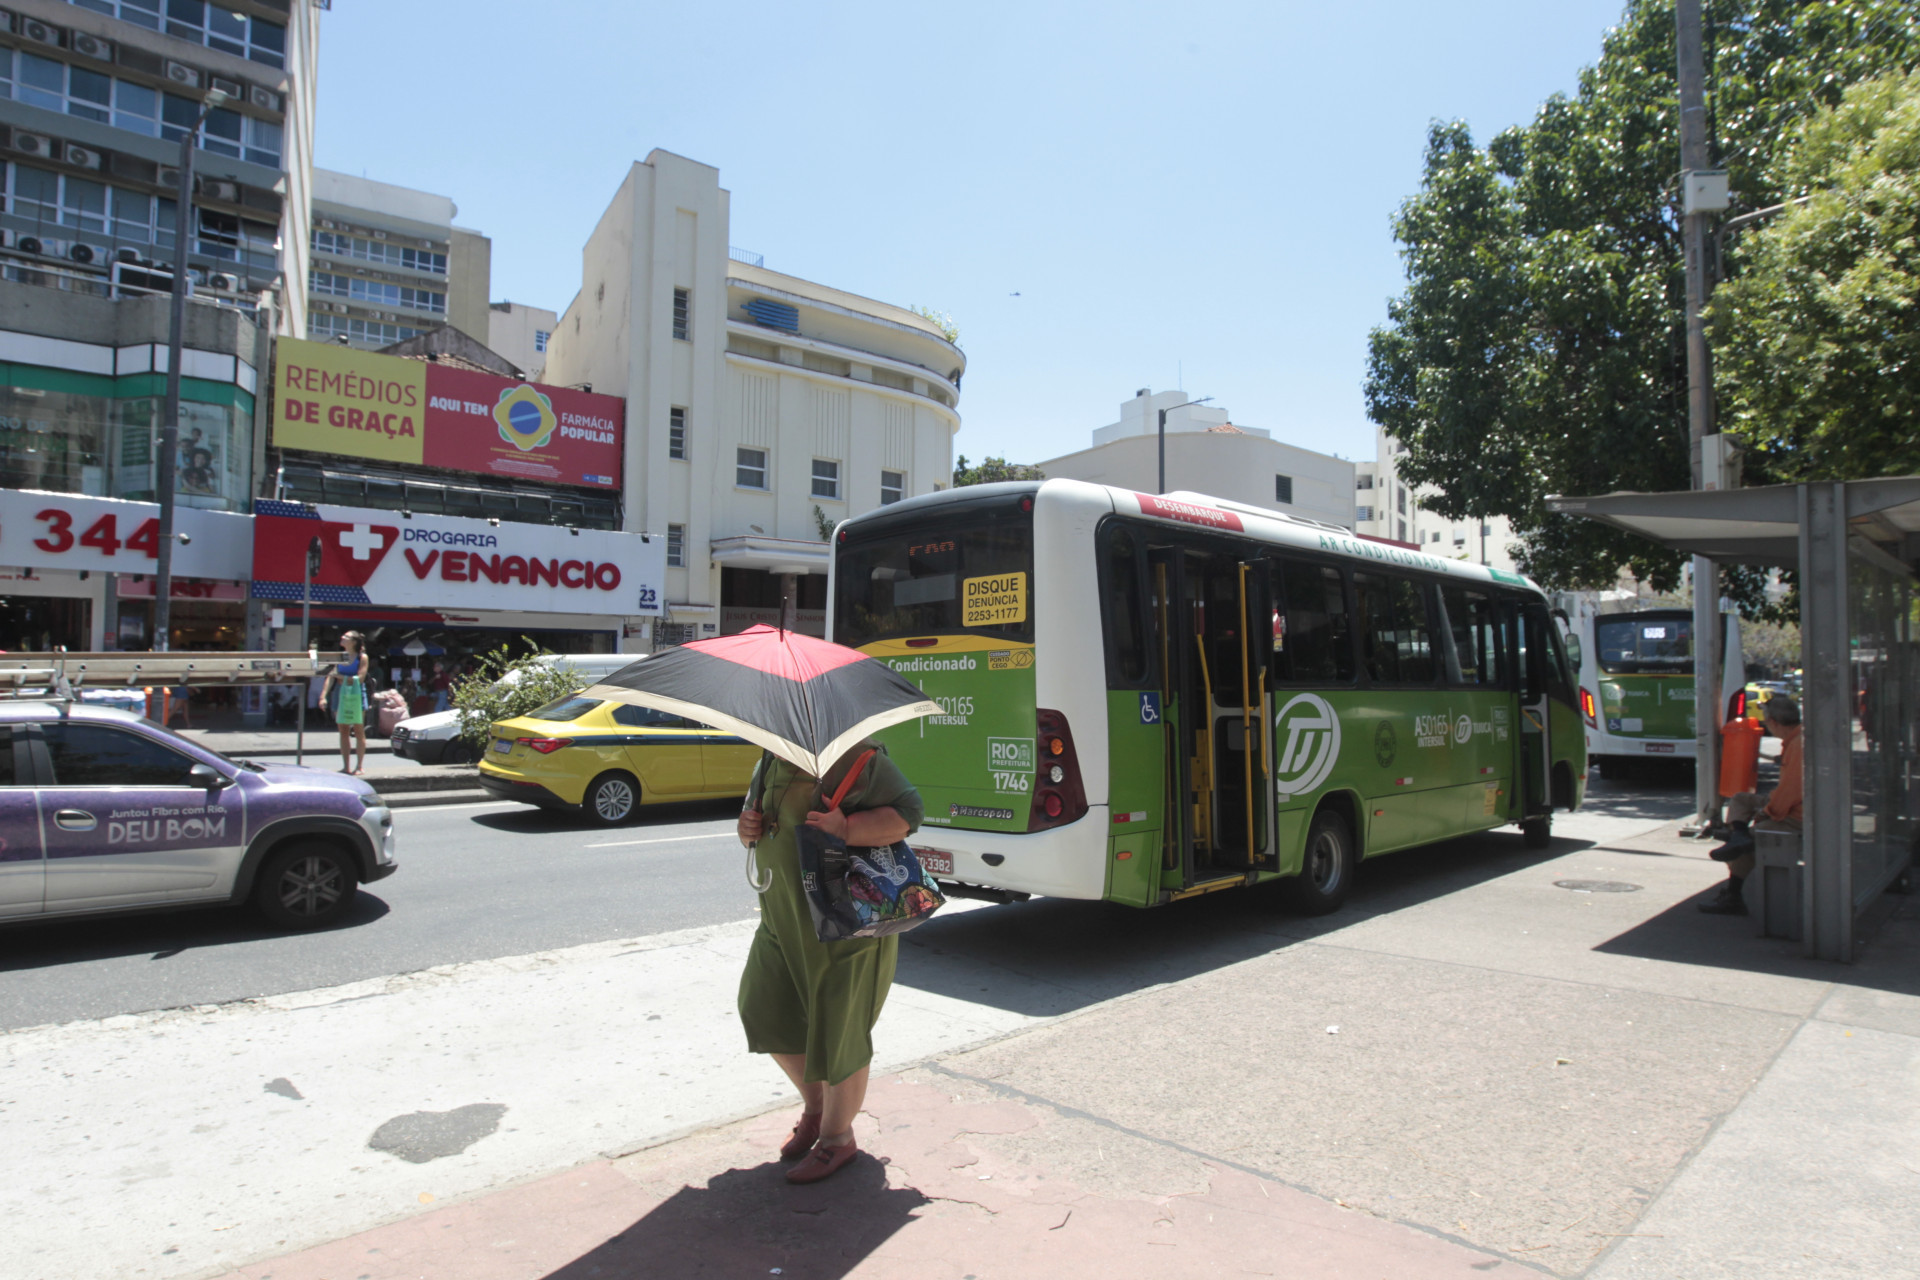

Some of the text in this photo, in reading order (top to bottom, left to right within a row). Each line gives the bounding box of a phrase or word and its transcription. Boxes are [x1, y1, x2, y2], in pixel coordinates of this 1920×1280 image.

[286, 364, 417, 407] REMÉDIOS
[429, 396, 488, 416] AQUI TEM
[285, 398, 415, 439] DE GRAÇA
[561, 412, 615, 431] FARMÁCIA
[560, 425, 615, 444] POPULAR
[1153, 499, 1227, 522] DESEMBARQUE
[33, 508, 160, 559] 344
[403, 528, 497, 548] DROGARIA
[1319, 535, 1448, 572] AR CONDICIONADO
[404, 547, 621, 591] VENANCIO
[639, 589, 656, 602] 23
[968, 577, 1018, 596] DISQUE
[968, 594, 1018, 608] DENÚNCIA
[968, 607, 1018, 621] 2253-1177
[888, 655, 977, 672] Condicionado
[931, 696, 974, 715] 50165
[928, 715, 969, 725] INTERSUL
[1414, 714, 1448, 736] A50165
[992, 743, 1018, 760] RIO
[993, 772, 1029, 791] 1746
[109, 809, 149, 818] Juntou
[152, 807, 179, 816] Fibra
[182, 807, 205, 815] com
[959, 806, 1012, 819] Marcopolo
[108, 816, 226, 844] DEU BOM
